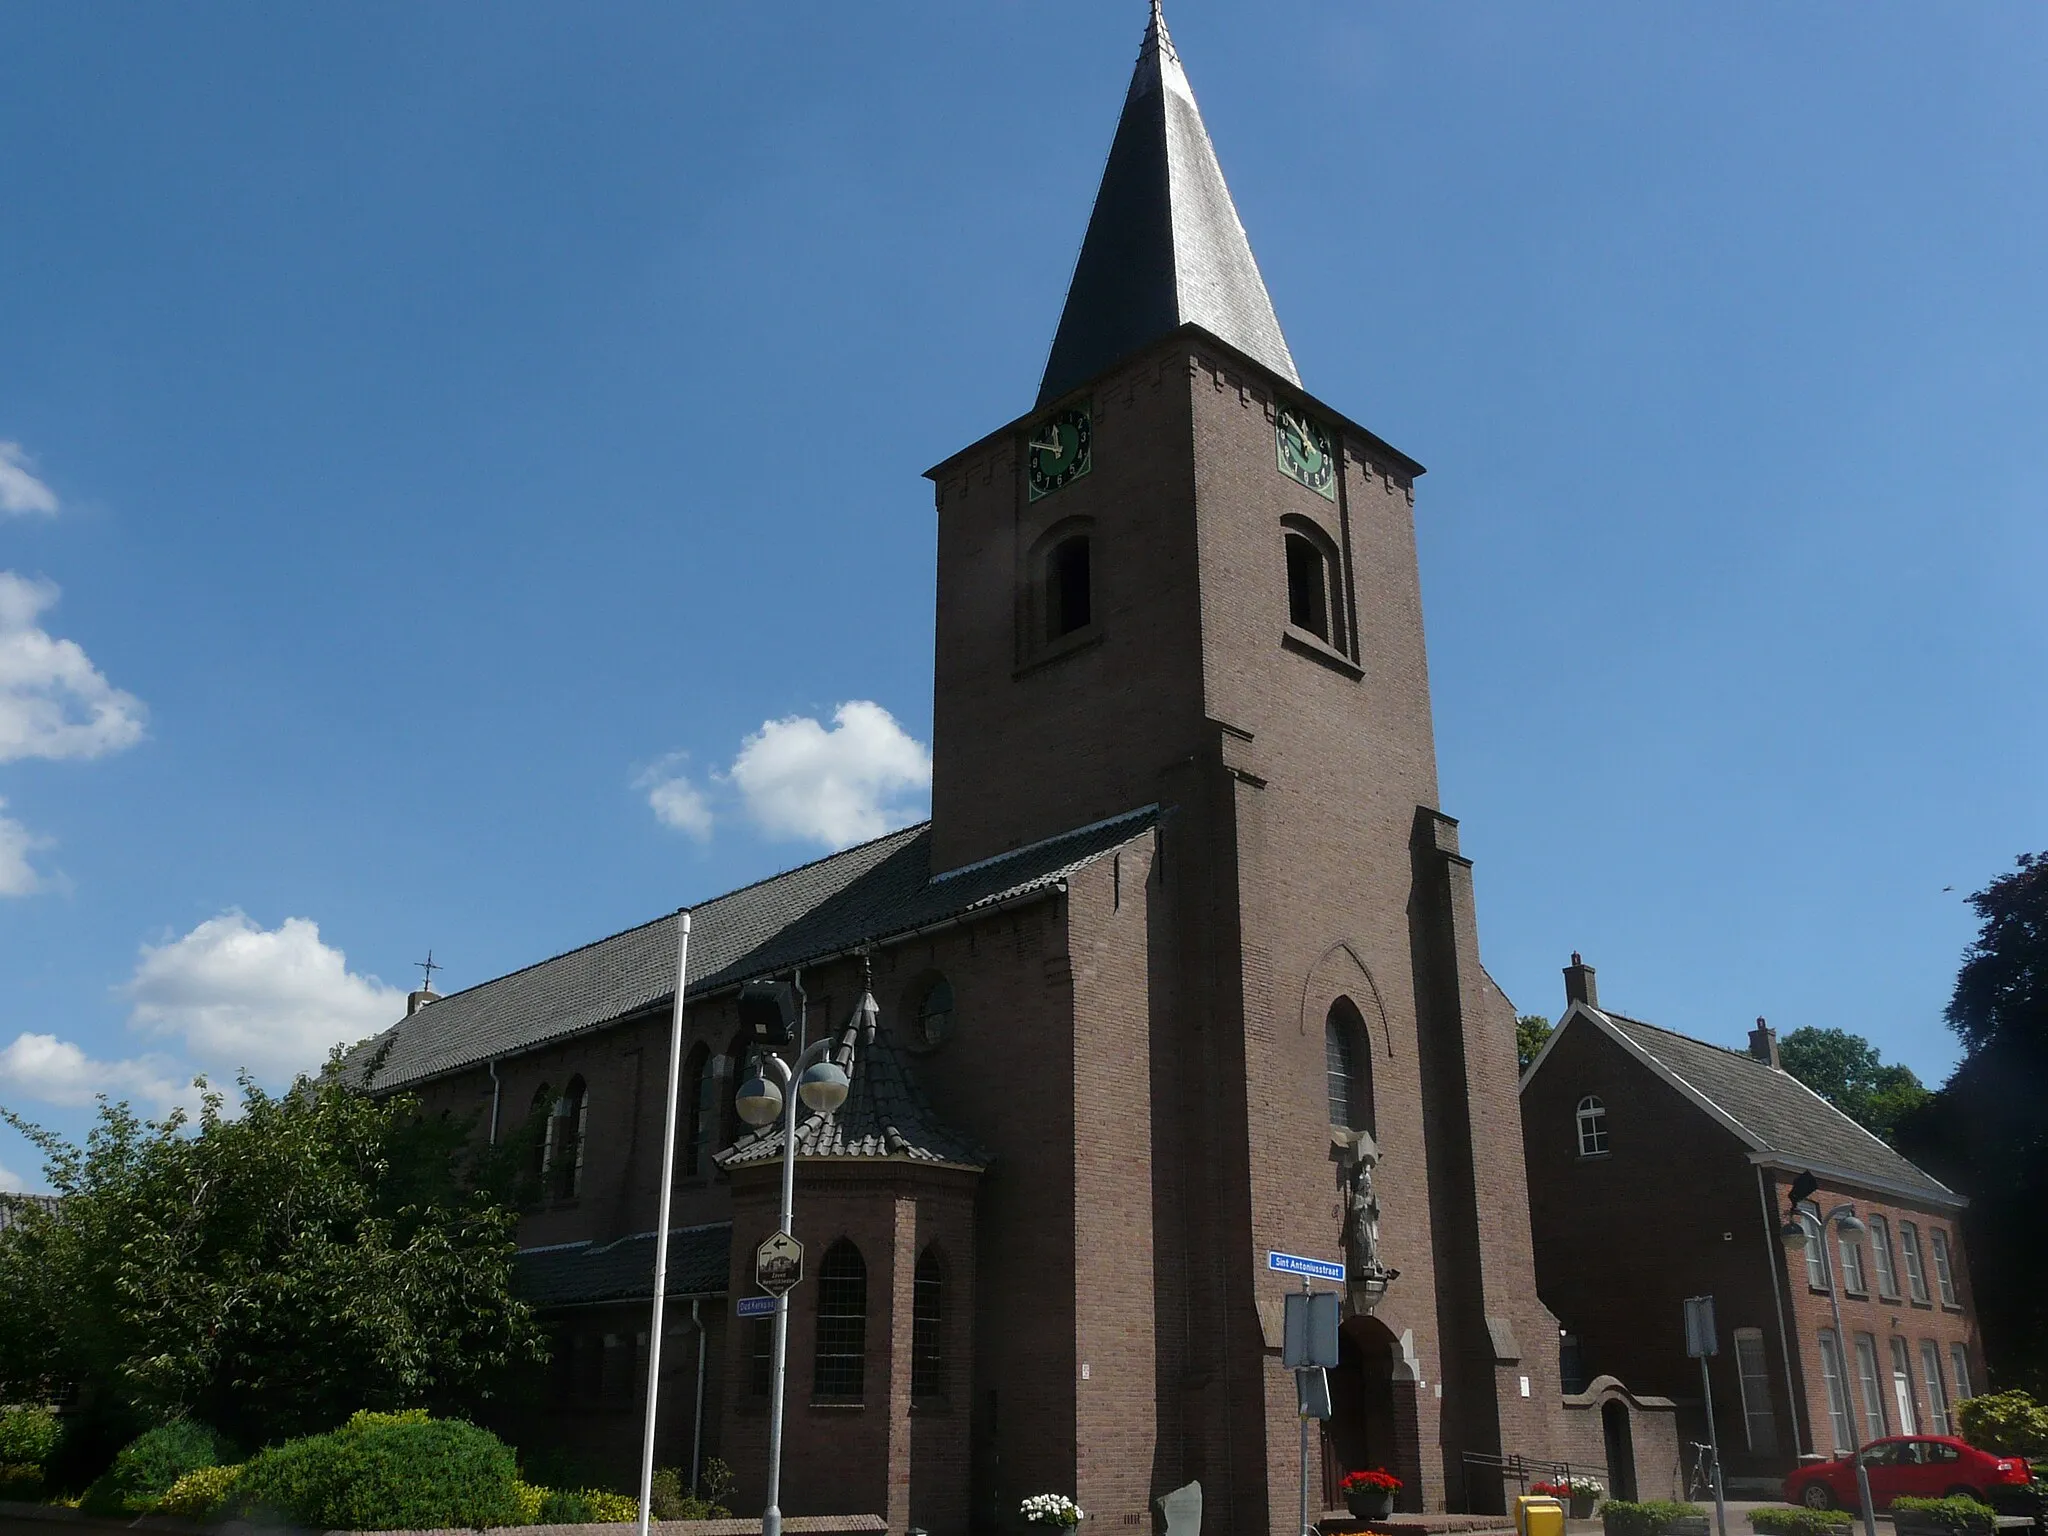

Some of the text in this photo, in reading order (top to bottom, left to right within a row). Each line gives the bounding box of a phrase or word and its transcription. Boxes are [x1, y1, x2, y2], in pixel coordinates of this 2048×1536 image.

[1078, 418, 1083, 429] 2
[1081, 431, 1087, 442] 3
[1319, 437, 1325, 449] 2
[1077, 449, 1083, 459] 4
[1284, 445, 1290, 457] 8
[1032, 457, 1038, 469] 9
[1323, 454, 1328, 465] 3
[1069, 463, 1075, 474] 5
[1293, 462, 1298, 473] 7
[1321, 467, 1326, 478] 4
[1036, 471, 1042, 483] 8
[1045, 476, 1050, 489] 7
[1057, 474, 1063, 485] 6
[1303, 471, 1309, 483] 6
[1315, 473, 1320, 485] 5
[1275, 1256, 1339, 1277] Sint Antoniusstraat
